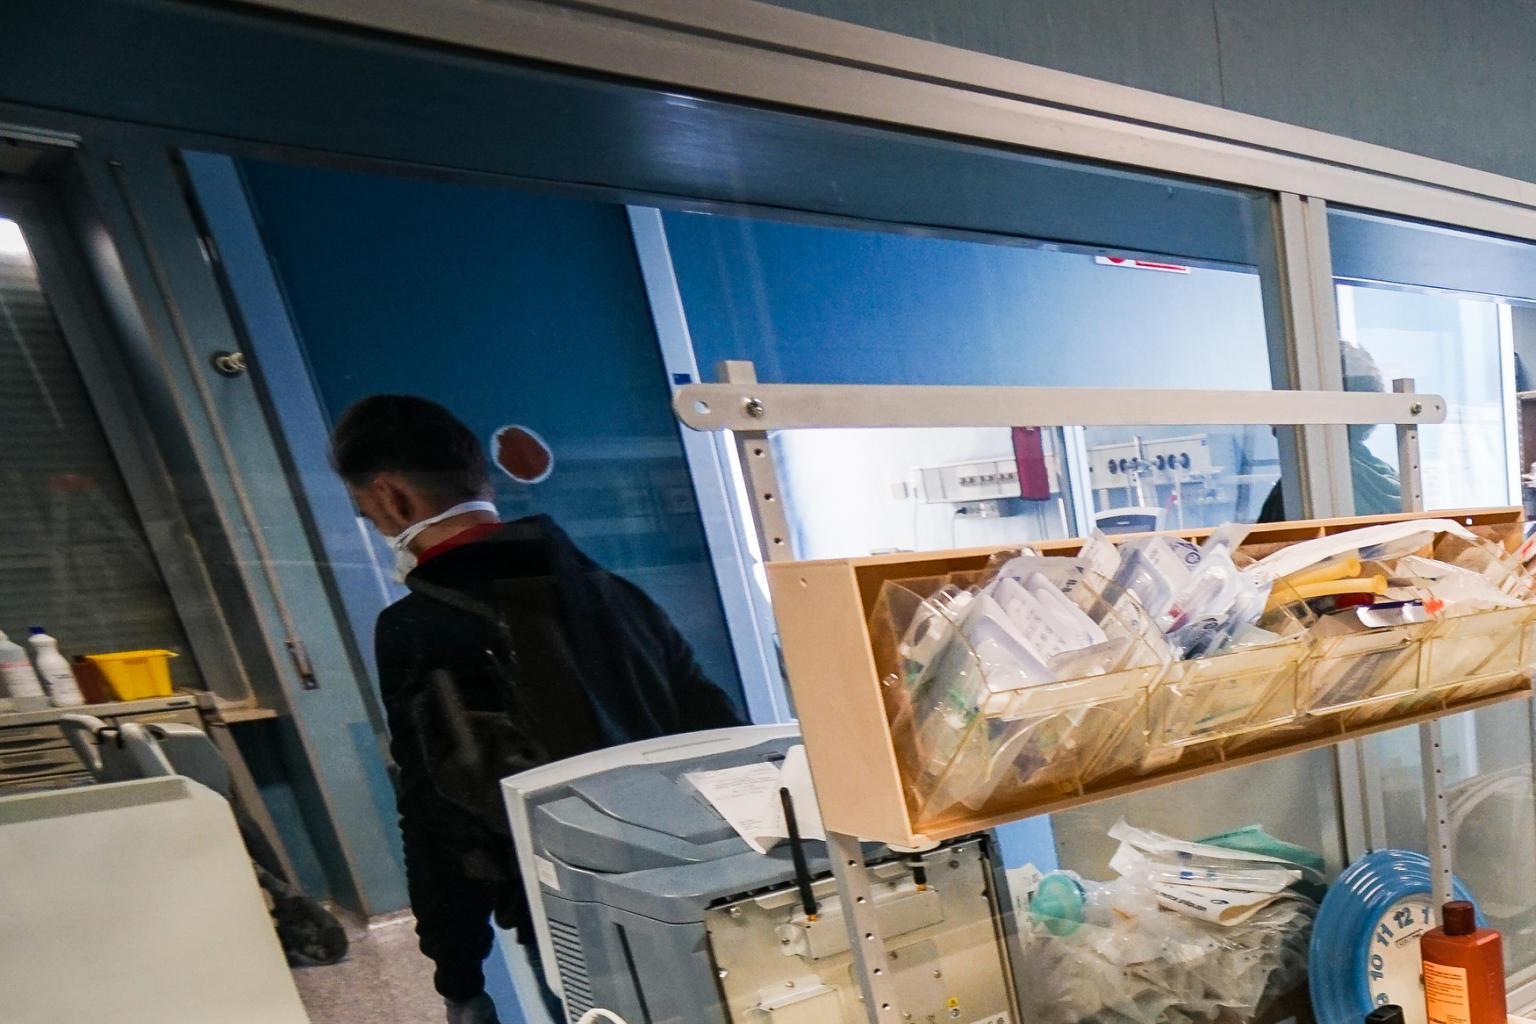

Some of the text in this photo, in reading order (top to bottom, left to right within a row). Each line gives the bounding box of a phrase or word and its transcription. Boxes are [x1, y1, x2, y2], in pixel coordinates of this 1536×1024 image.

[1393, 907, 1414, 929] 12
[1421, 906, 1429, 924] 1
[1376, 923, 1394, 947] 11
[1371, 954, 1384, 981] 10
